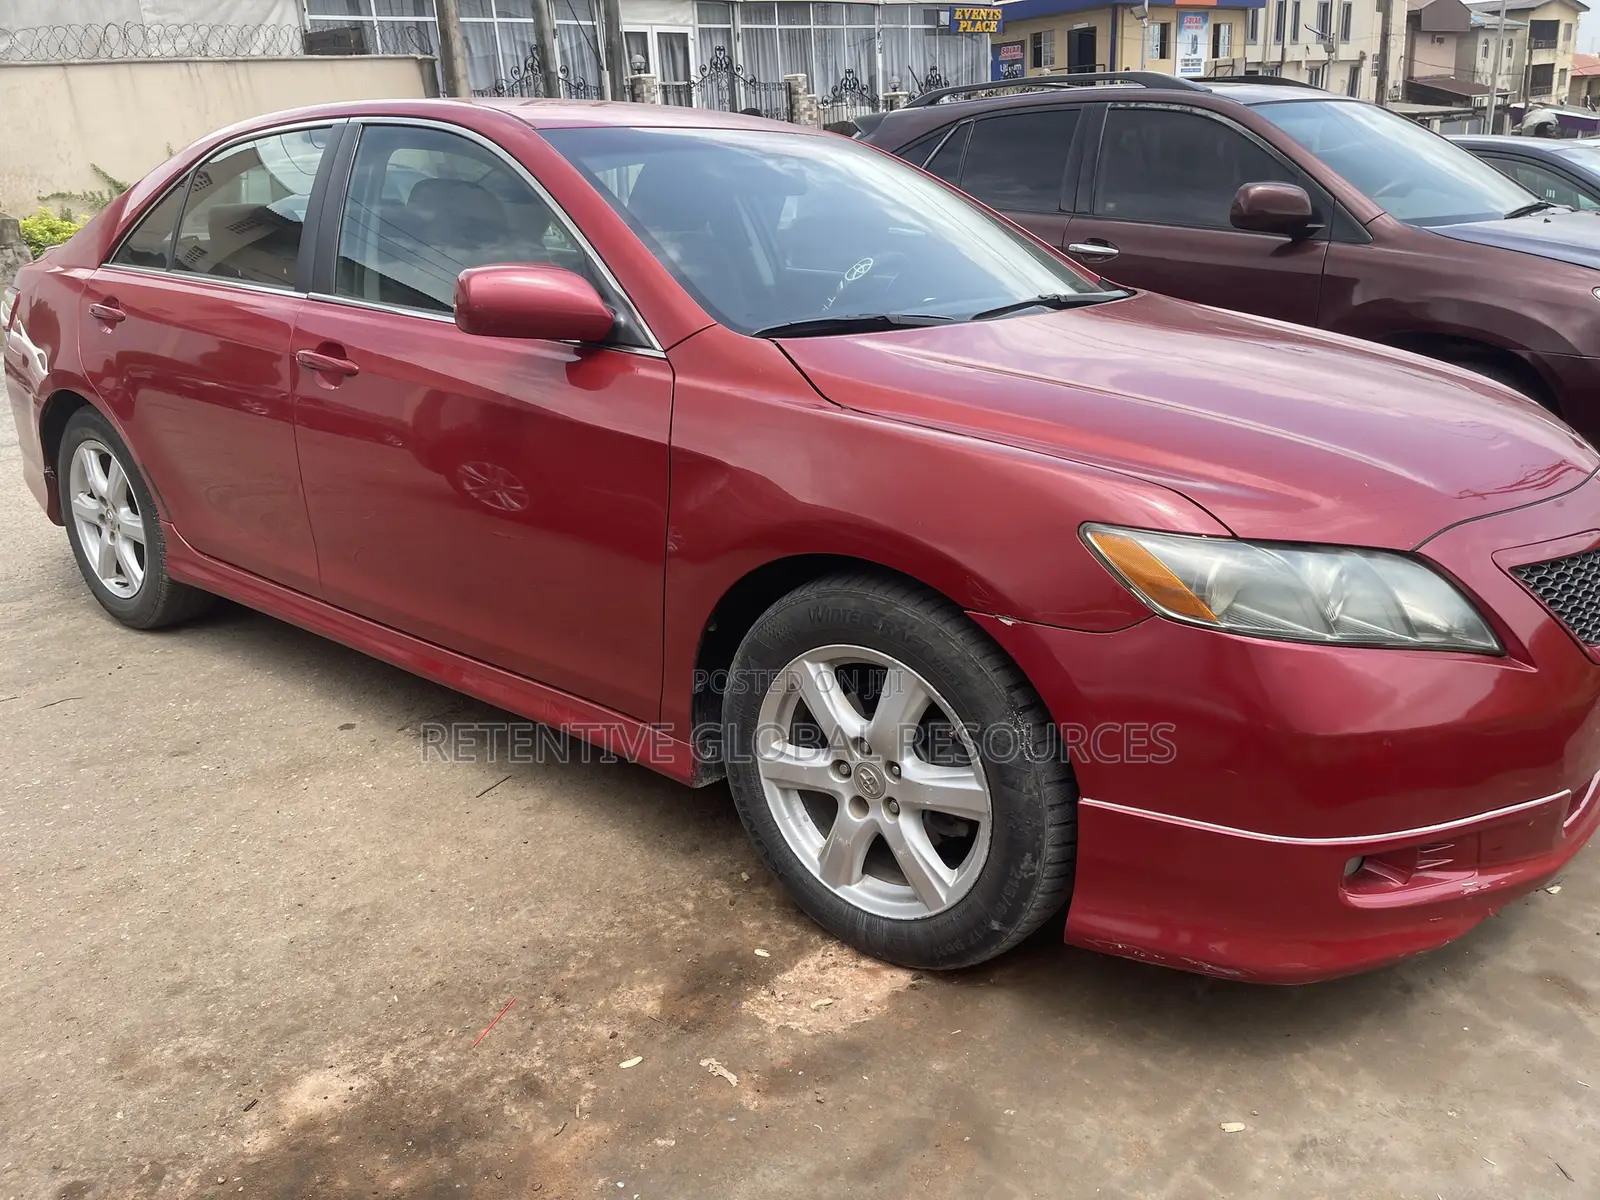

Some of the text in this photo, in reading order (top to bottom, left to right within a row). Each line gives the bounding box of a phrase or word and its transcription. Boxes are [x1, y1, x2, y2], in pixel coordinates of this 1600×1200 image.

[954, 8, 1002, 20] EVENTS
[958, 21, 997, 32] PLACE
[1002, 45, 1021, 54] SOLAR
